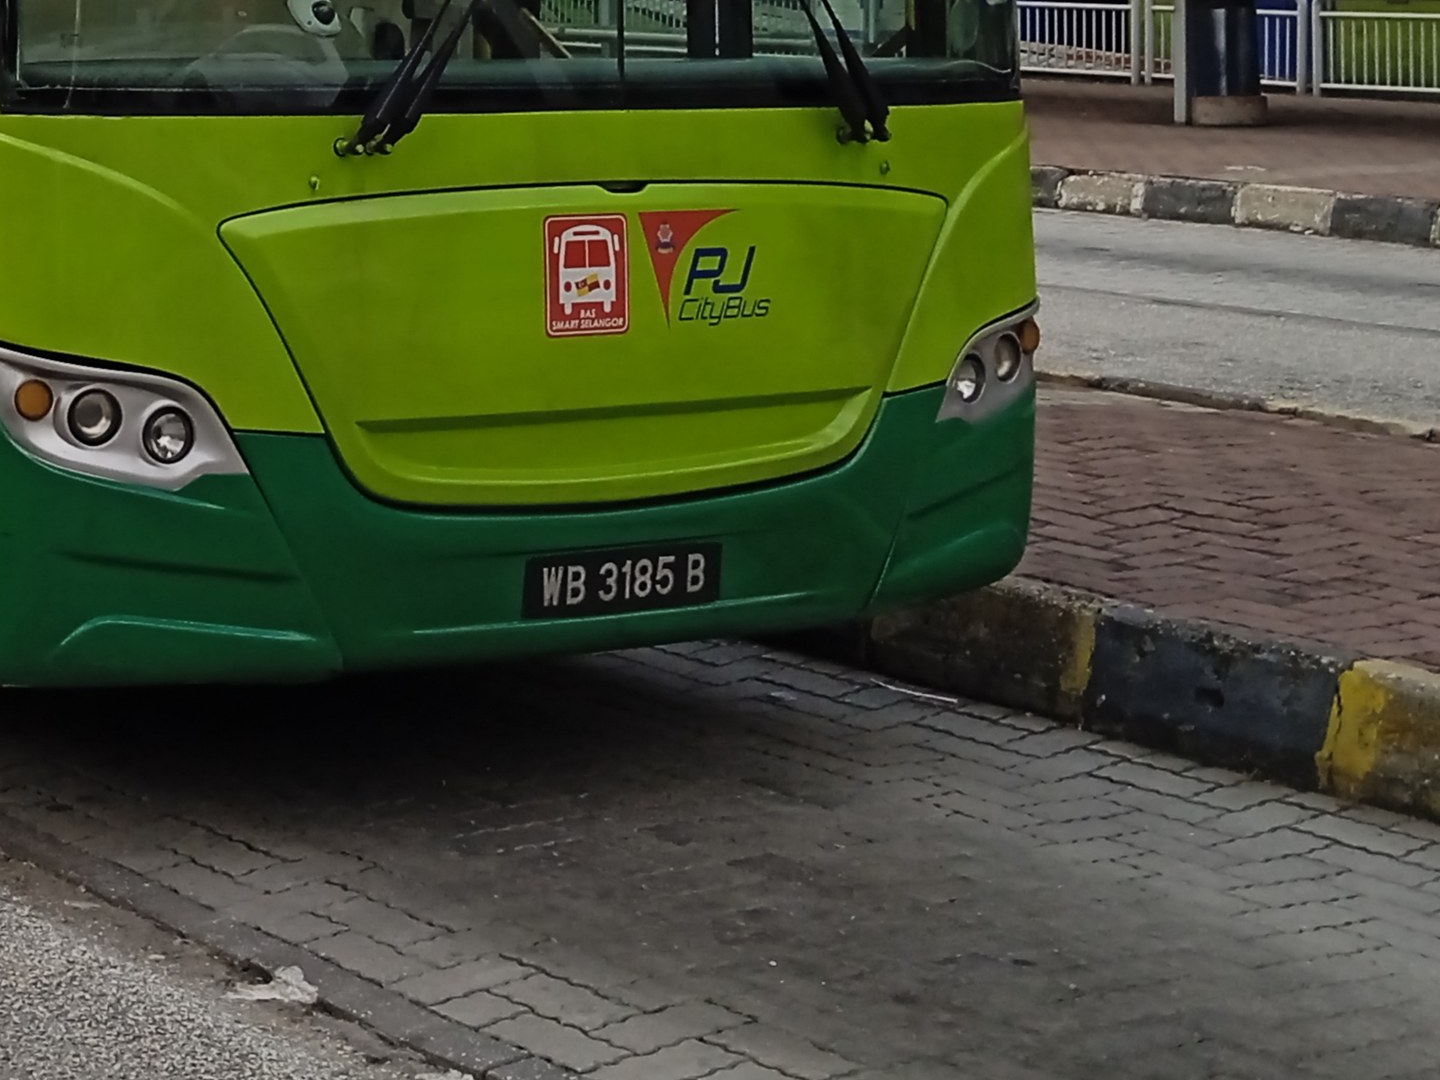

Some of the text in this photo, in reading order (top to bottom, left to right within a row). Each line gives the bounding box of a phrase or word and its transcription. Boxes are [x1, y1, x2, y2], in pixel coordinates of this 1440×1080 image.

[684, 245, 756, 296] PJ
[551, 316, 625, 332] SMART SELANGOR
[579, 308, 597, 320] BAS
[678, 296, 772, 327] CityBus
[542, 552, 706, 607] WB 3185 B
